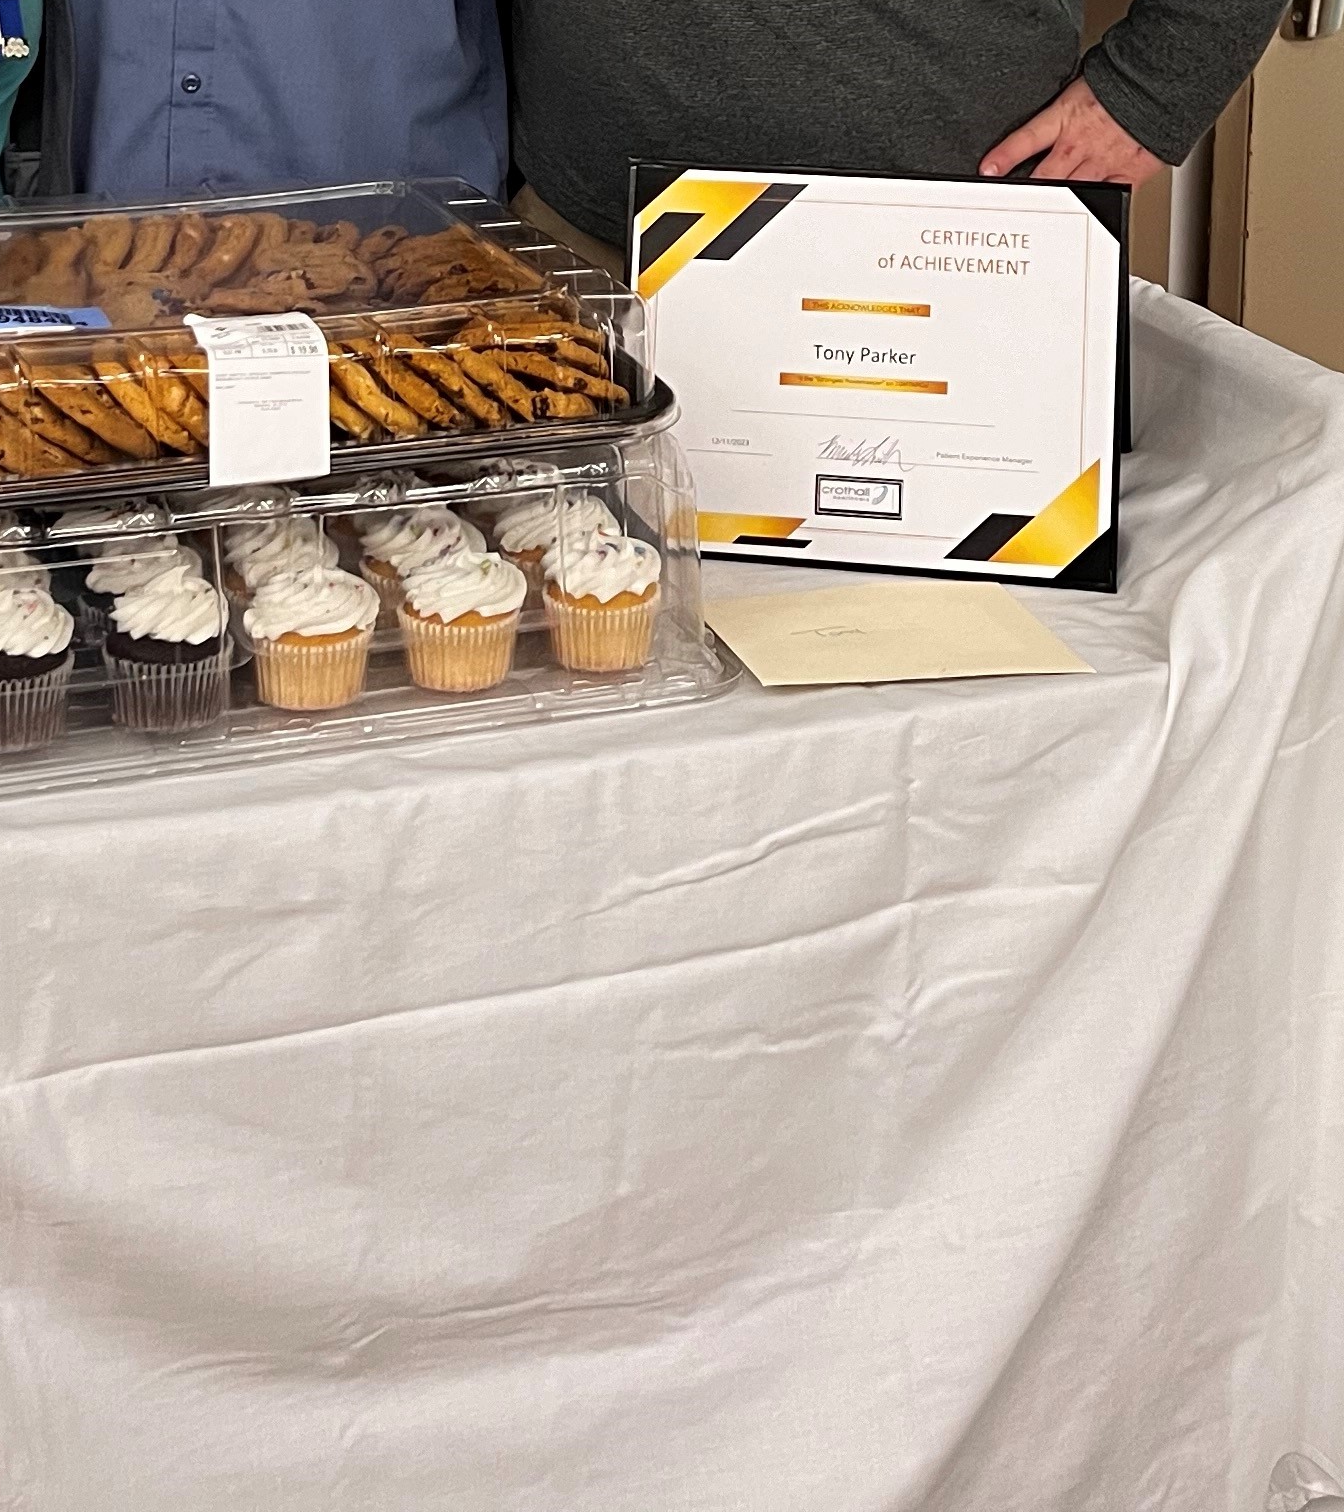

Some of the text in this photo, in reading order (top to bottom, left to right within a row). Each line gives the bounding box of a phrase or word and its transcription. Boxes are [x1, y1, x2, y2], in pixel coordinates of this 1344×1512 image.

[920, 229, 1031, 249] CERTIFICATE
[878, 253, 1031, 276] of ACHIEVEMENT
[812, 301, 829, 310] THIS
[813, 344, 917, 365] Tony Parker
[822, 486, 870, 496] crothall
